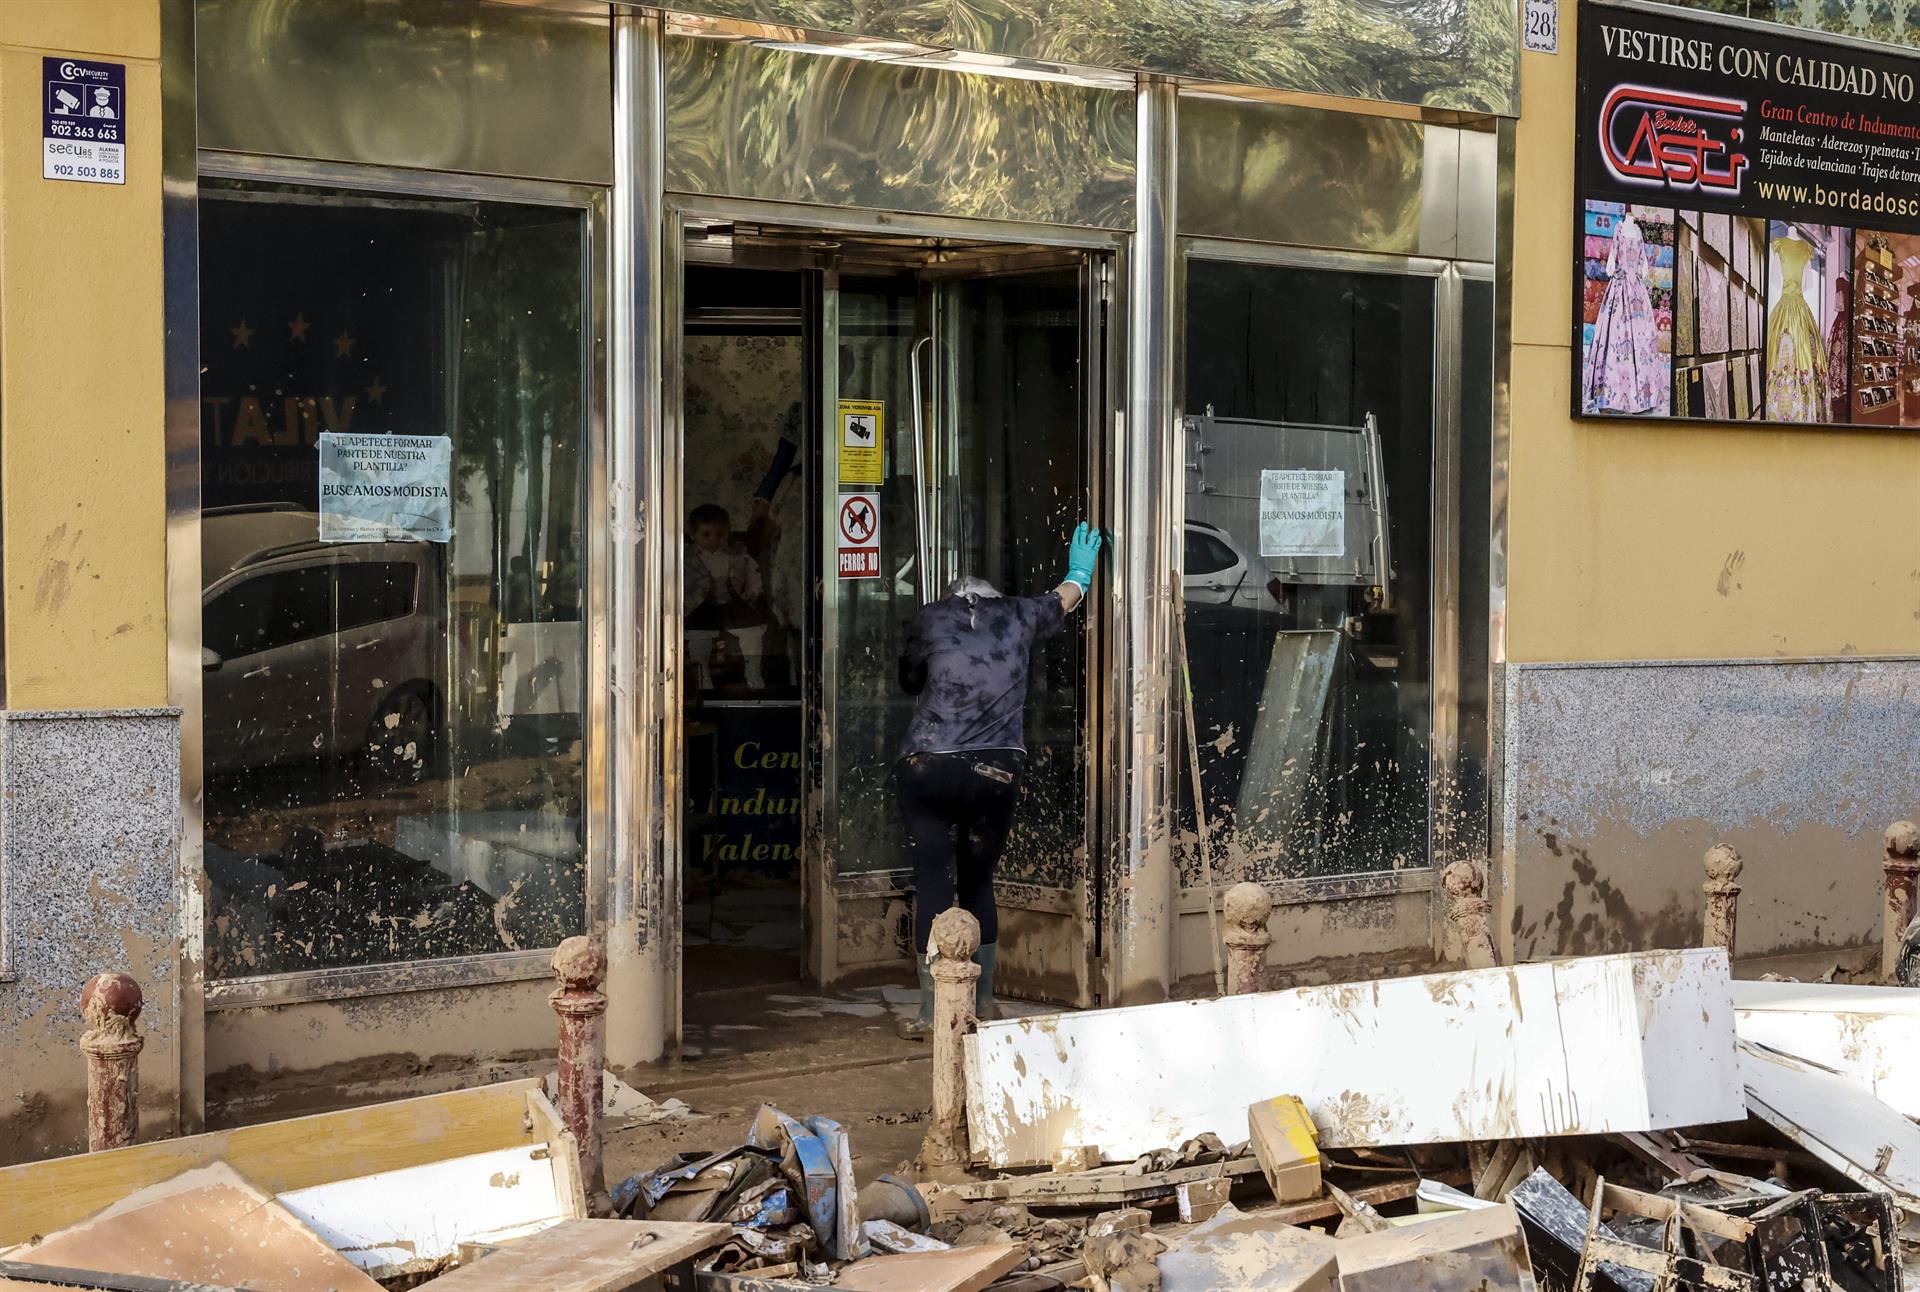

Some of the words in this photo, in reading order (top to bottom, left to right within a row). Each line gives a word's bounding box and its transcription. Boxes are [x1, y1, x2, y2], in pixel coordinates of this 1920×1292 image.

[1530, 10, 1551, 37] 28
[1600, 25, 1713, 72] VESTIRSE
[1718, 45, 1771, 81] CON
[1775, 54, 1877, 96] CALIDAD
[1881, 71, 1914, 103] NO
[1760, 99, 1793, 122] Gran
[1797, 104, 1838, 128] Centro
[1841, 111, 1855, 130] de
[51, 124, 71, 136] 902
[74, 127, 94, 138] 363
[97, 128, 118, 140] 663
[1760, 125, 1816, 148] Manteletas
[1820, 134, 1863, 154] Aderezos
[1862, 144, 1870, 160] y
[1870, 142, 1910, 161] peinetas
[54, 164, 74, 175] 902
[77, 166, 97, 178] 503
[100, 168, 120, 179] 885
[1760, 148, 1792, 170] Tejidos
[1794, 153, 1805, 168] de
[1807, 155, 1857, 175] valenciana
[1861, 161, 1888, 184] Trajes
[1889, 165, 1900, 180] de
[1758, 181, 1919, 216] www.bordadosc
[349, 437, 393, 448] APETECE
[394, 439, 432, 449] FORMAR
[337, 449, 368, 459] PARTE
[369, 450, 383, 460] DE
[384, 450, 426, 461] NUESTRA
[353, 461, 408, 472] PLANTILLA?
[323, 484, 392, 497] BUSCAMOS
[394, 486, 448, 497] MODISTA
[1262, 511, 1307, 520] BUSCAMOS
[1306, 511, 1343, 520] MODISTA
[840, 552, 865, 571] PERROS
[868, 552, 878, 571] NO
[734, 741, 800, 769] Cen
